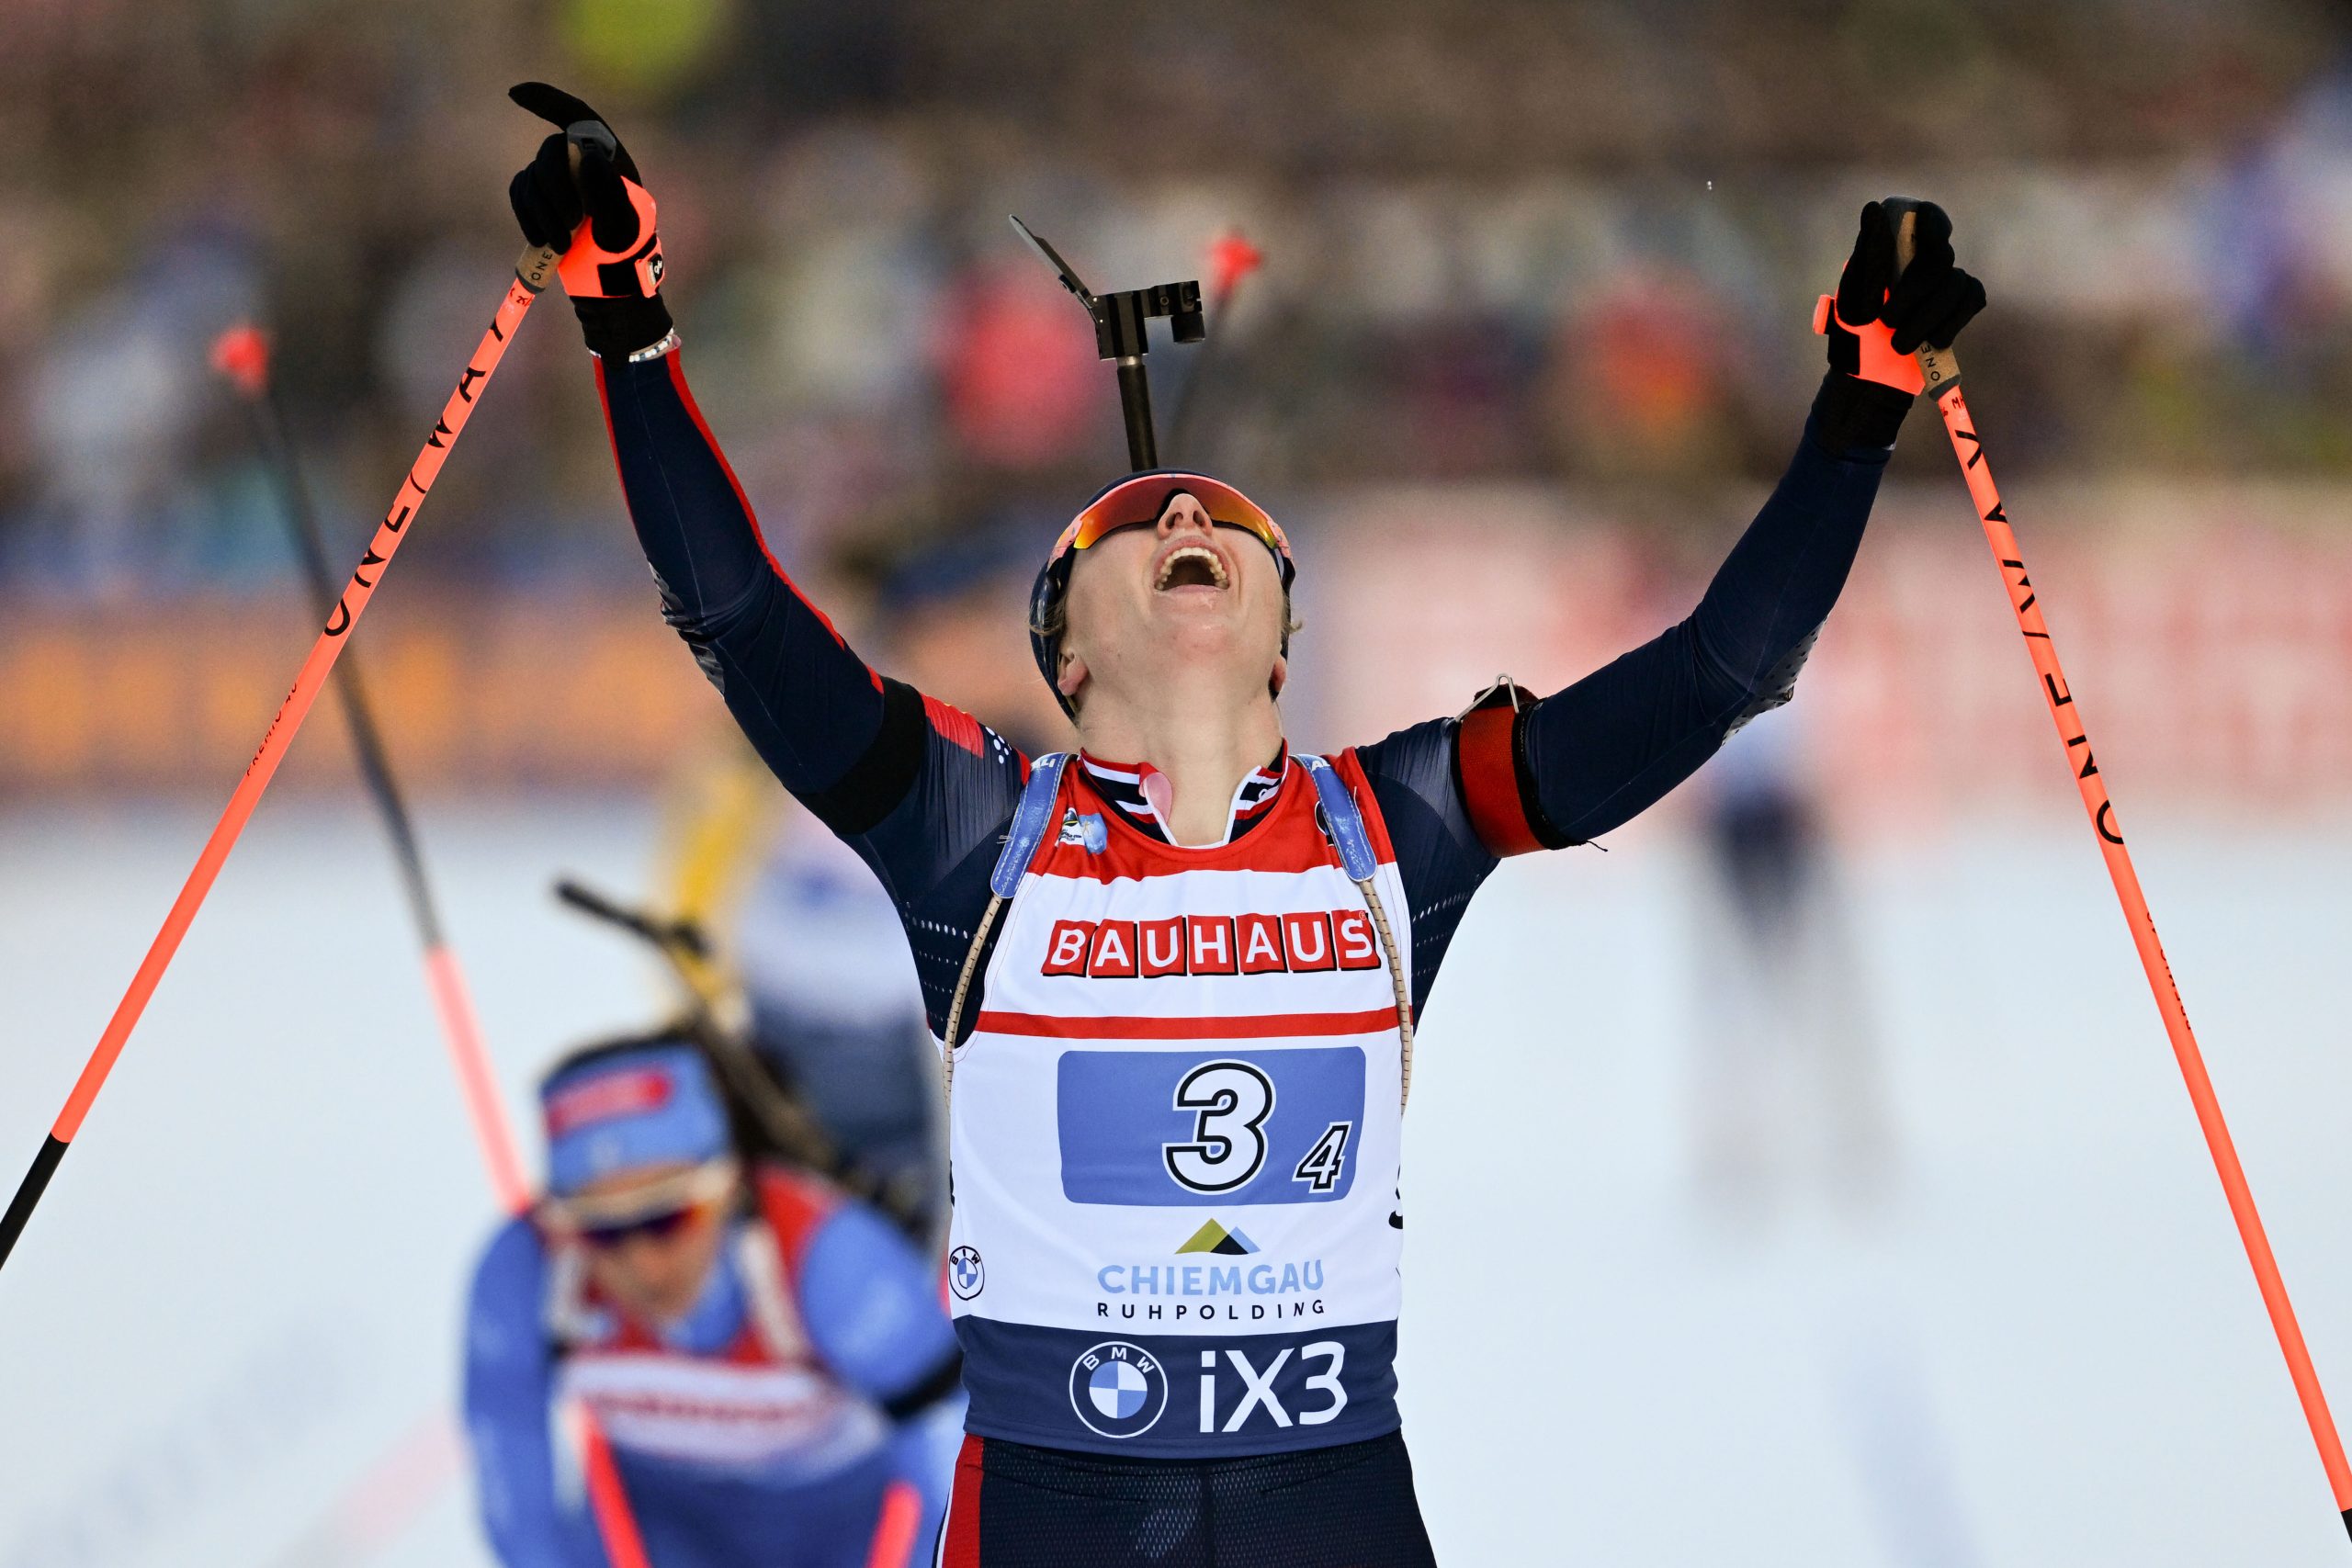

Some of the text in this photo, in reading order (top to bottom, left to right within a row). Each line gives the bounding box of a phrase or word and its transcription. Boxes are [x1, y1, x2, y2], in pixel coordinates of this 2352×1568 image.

[531, 251, 553, 280] ONE
[1920, 345, 1940, 381] ONE
[1049, 918, 1374, 968] BAUHAUS
[1161, 1058, 1353, 1196] 3 4
[1097, 1259, 1325, 1296] CHIEMGAU
[1097, 1299, 1325, 1320] RUHPOLDING
[1081, 1345, 1156, 1374] BMW
[1199, 1340, 1349, 1434] iX3
